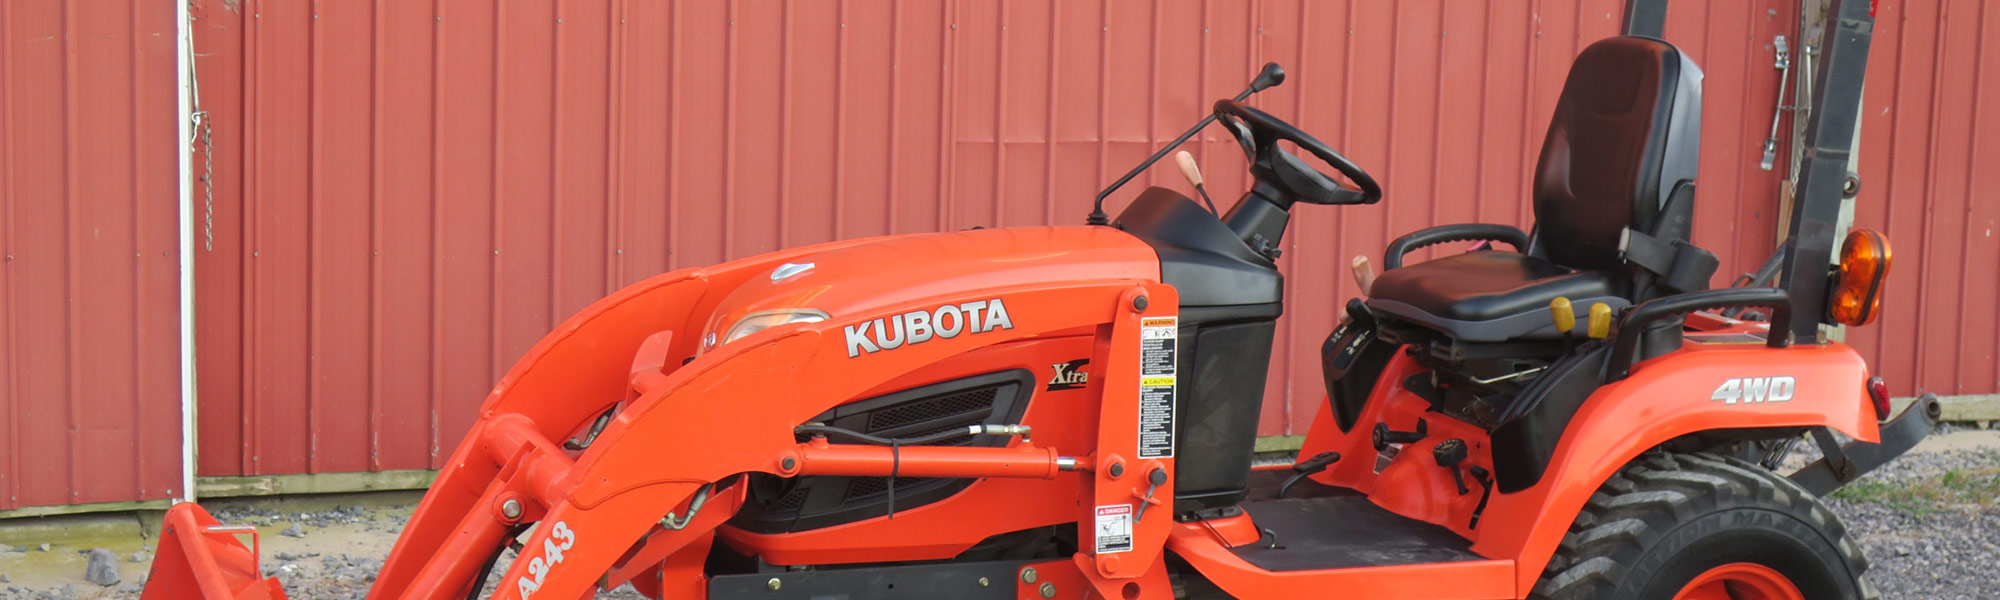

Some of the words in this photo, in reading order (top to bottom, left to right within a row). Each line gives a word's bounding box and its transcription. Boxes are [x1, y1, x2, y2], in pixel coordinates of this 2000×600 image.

[844, 298, 1014, 358] KUBOTA
[1048, 363, 1089, 384] Xtra
[1710, 375, 1797, 405] 4WD
[1104, 506, 1129, 514] DANGER
[517, 521, 575, 600] A243
